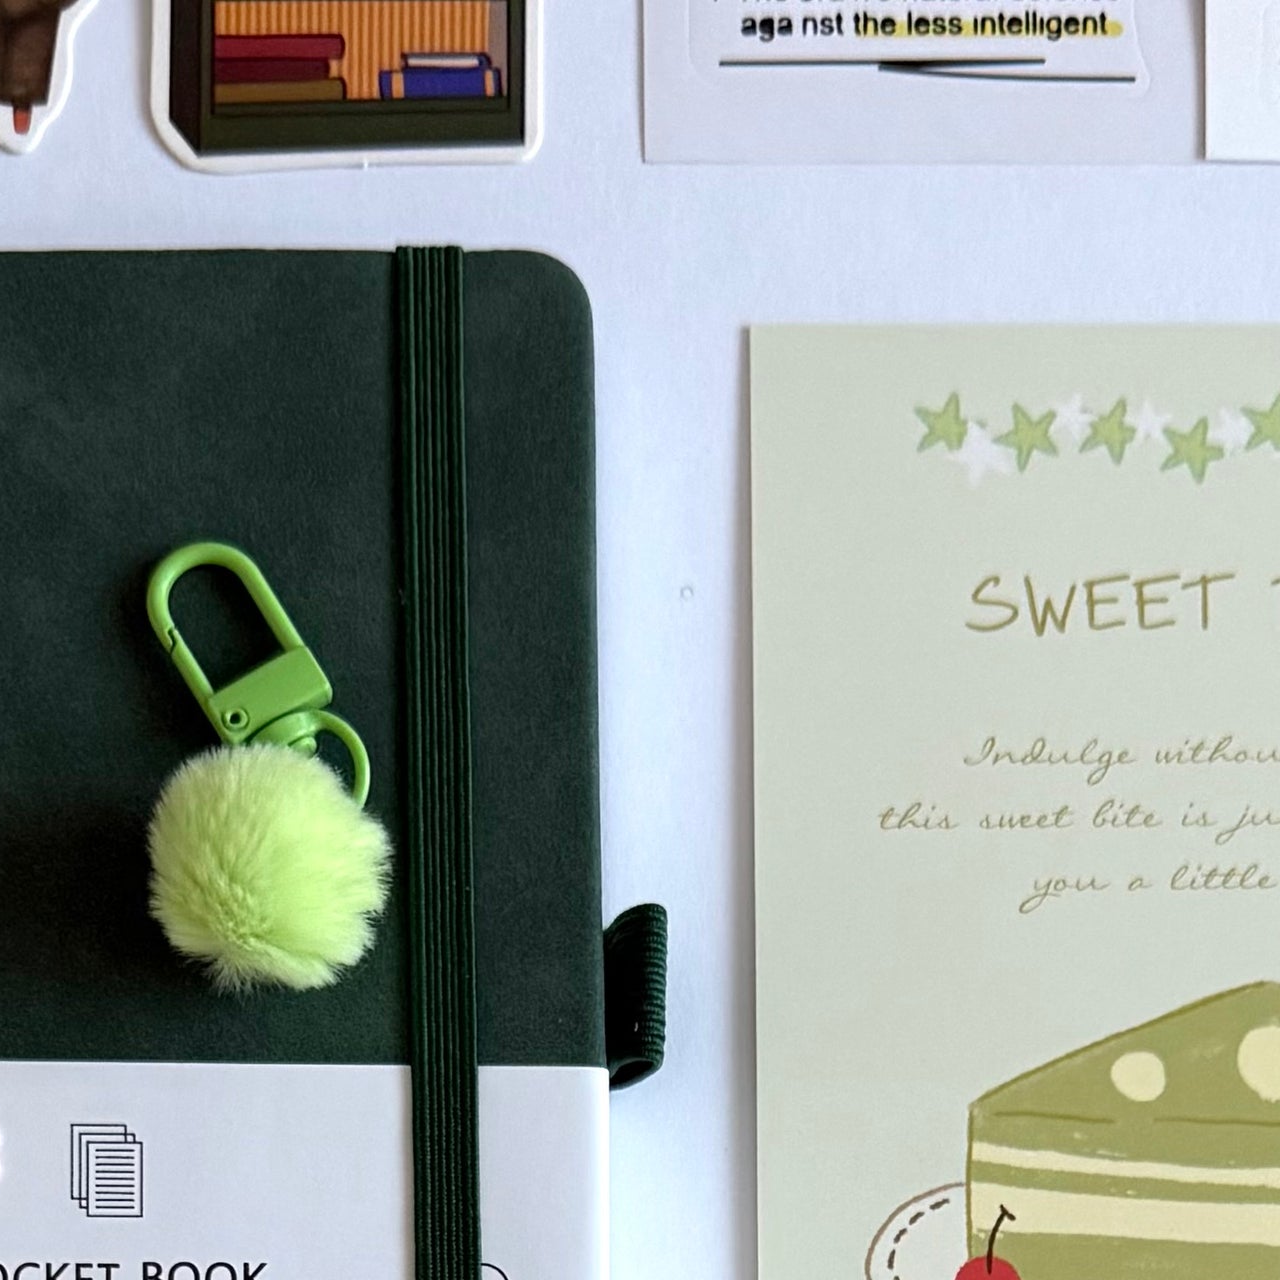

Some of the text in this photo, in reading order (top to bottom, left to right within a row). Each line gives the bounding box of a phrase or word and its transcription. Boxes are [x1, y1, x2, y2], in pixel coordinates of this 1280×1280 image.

[854, 12, 896, 36] the
[907, 11, 962, 36] less
[964, 572, 1237, 638] SWEET
[963, 736, 1137, 786] Indulge
[877, 801, 960, 830] this
[978, 805, 1073, 829] sweet
[1092, 799, 1165, 828] bite
[1180, 802, 1218, 827] is
[1018, 876, 1111, 915] you
[1127, 876, 1154, 891] a
[1169, 865, 1279, 890] little
